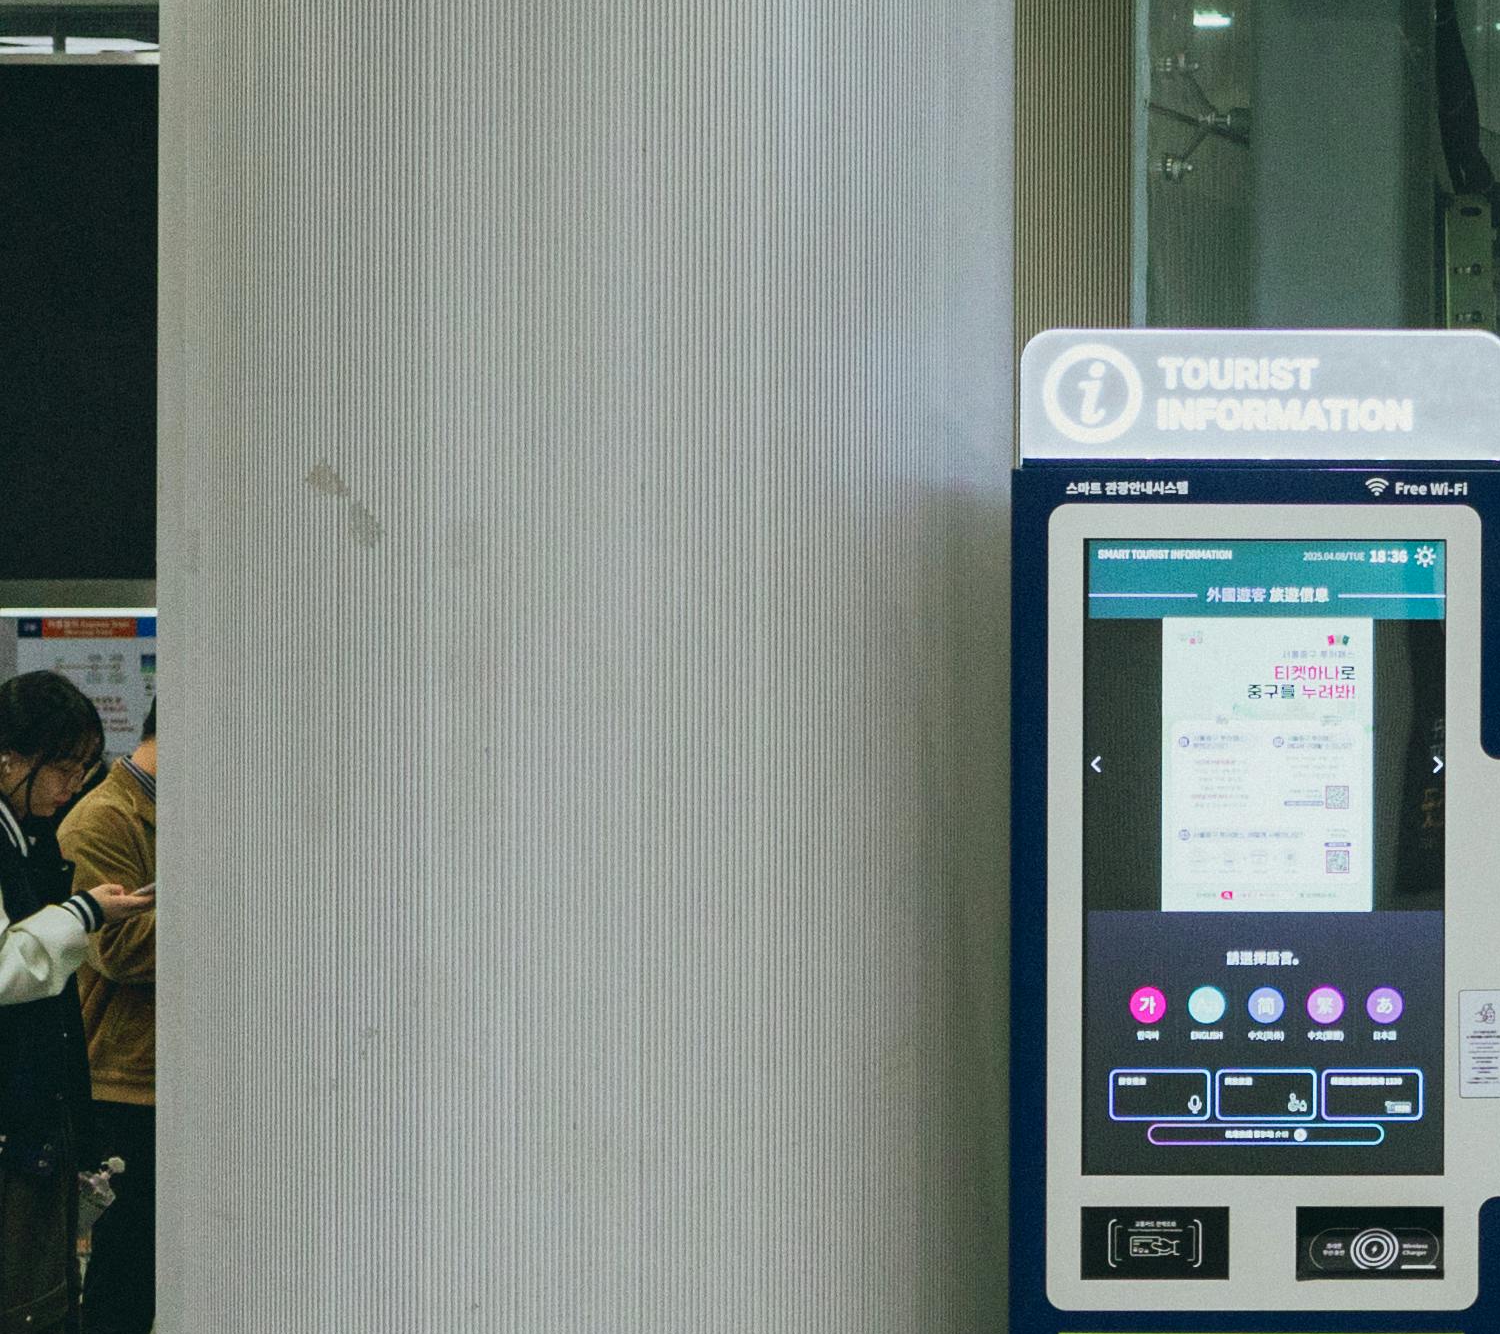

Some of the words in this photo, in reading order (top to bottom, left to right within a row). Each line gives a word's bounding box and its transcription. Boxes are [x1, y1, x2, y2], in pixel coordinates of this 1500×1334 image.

[1157, 356, 1321, 391] TOURIST
[1156, 397, 1414, 432] INFORMATION
[1066, 481, 1102, 495] 스마트
[1105, 480, 1189, 496] 관광안내시스템
[1395, 481, 1428, 496] Free
[1430, 481, 1468, 496] Wi-Fi
[1097, 548, 1130, 560] SMART
[1132, 548, 1168, 560] TOURIST
[1170, 548, 1233, 560] INFORMATION
[1274, 665, 1356, 681] 티켓하나로
[1248, 683, 1295, 699] 중구를
[1302, 684, 1356, 699] 누려봐!
[1139, 996, 1156, 1014] 가
[1376, 997, 1394, 1014] あ
[1190, 1030, 1224, 1040] ENGLISH
